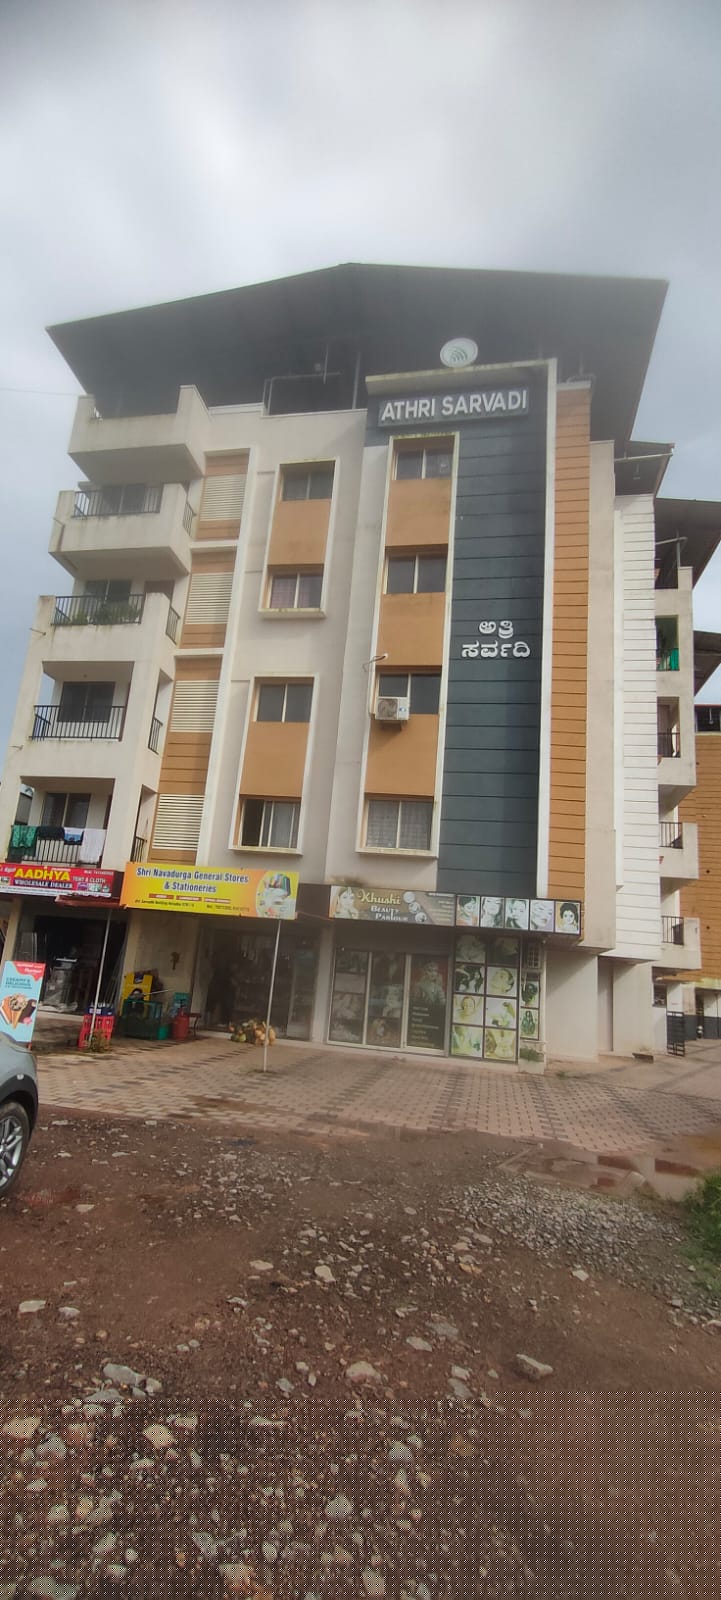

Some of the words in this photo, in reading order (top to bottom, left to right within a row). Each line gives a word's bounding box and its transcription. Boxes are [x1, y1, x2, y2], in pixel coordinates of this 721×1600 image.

[381, 398, 436, 421] ATHRI
[441, 390, 527, 416] SARVADI
[478, 620, 514, 639] ಅತ್ರಿ
[461, 639, 531, 658] ಸರ್ವದಿ
[14, 868, 71, 881] AADHYA
[136, 867, 151, 876] Shri
[153, 868, 192, 881] Navadurga
[194, 871, 223, 881] General
[224, 873, 249, 883] Stores
[14, 879, 49, 888] WHOLESALE
[164, 881, 170, 890] &
[172, 881, 217, 893] Stationeries
[357, 888, 401, 905] Khushi
